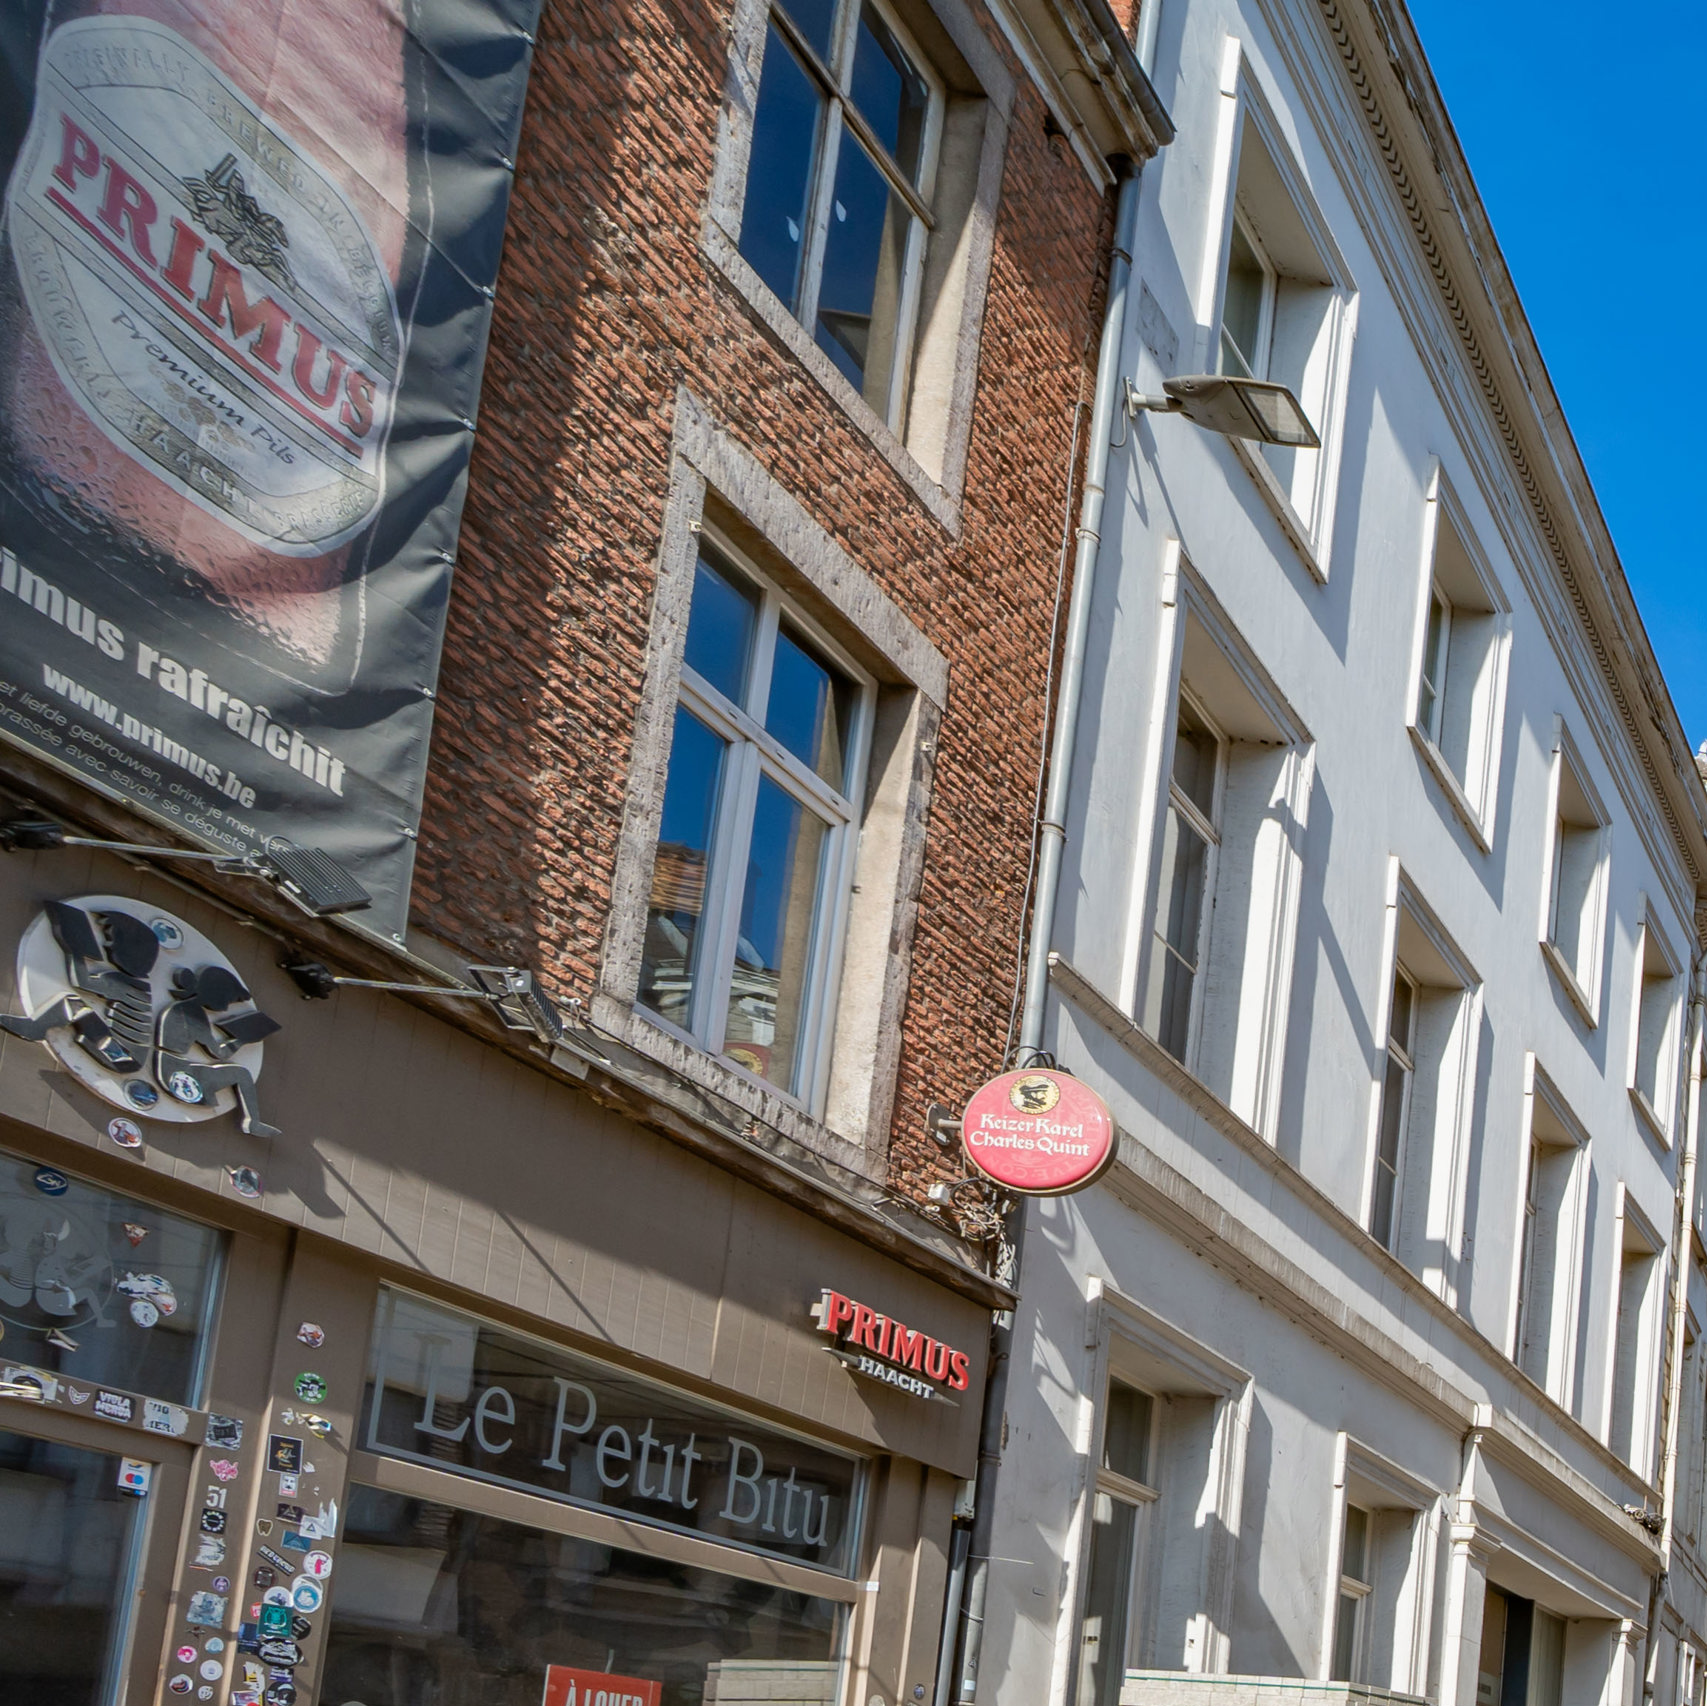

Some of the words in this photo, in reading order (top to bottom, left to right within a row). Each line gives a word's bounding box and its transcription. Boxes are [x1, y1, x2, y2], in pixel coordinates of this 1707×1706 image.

[53, 111, 377, 438] PRIMUS
[111, 309, 246, 427] Premium
[250, 423, 296, 466] Pils
[20, 691, 67, 727] liefde
[70, 721, 164, 788] gebrouwen,
[168, 779, 207, 813] drink
[206, 801, 223, 821] je
[225, 812, 258, 841] met
[43, 663, 257, 809] www.primus.be
[136, 641, 347, 797] rafraîchit
[65, 743, 108, 774] avec
[110, 760, 160, 803] savoir
[161, 796, 182, 816] se
[184, 806, 248, 854] déguste
[969, 1130, 1036, 1151] Charles
[1036, 1136, 1091, 1157] Quint
[980, 1113, 1035, 1133] Keizer
[1035, 1118, 1084, 1139] Karel
[821, 1289, 970, 1391] PRIMUS
[858, 1355, 935, 1400] HAACHT
[205, 1485, 228, 1509] 51
[413, 1334, 517, 1456] Le
[542, 1376, 703, 1510] Petit
[718, 1436, 829, 1548] Bitu
